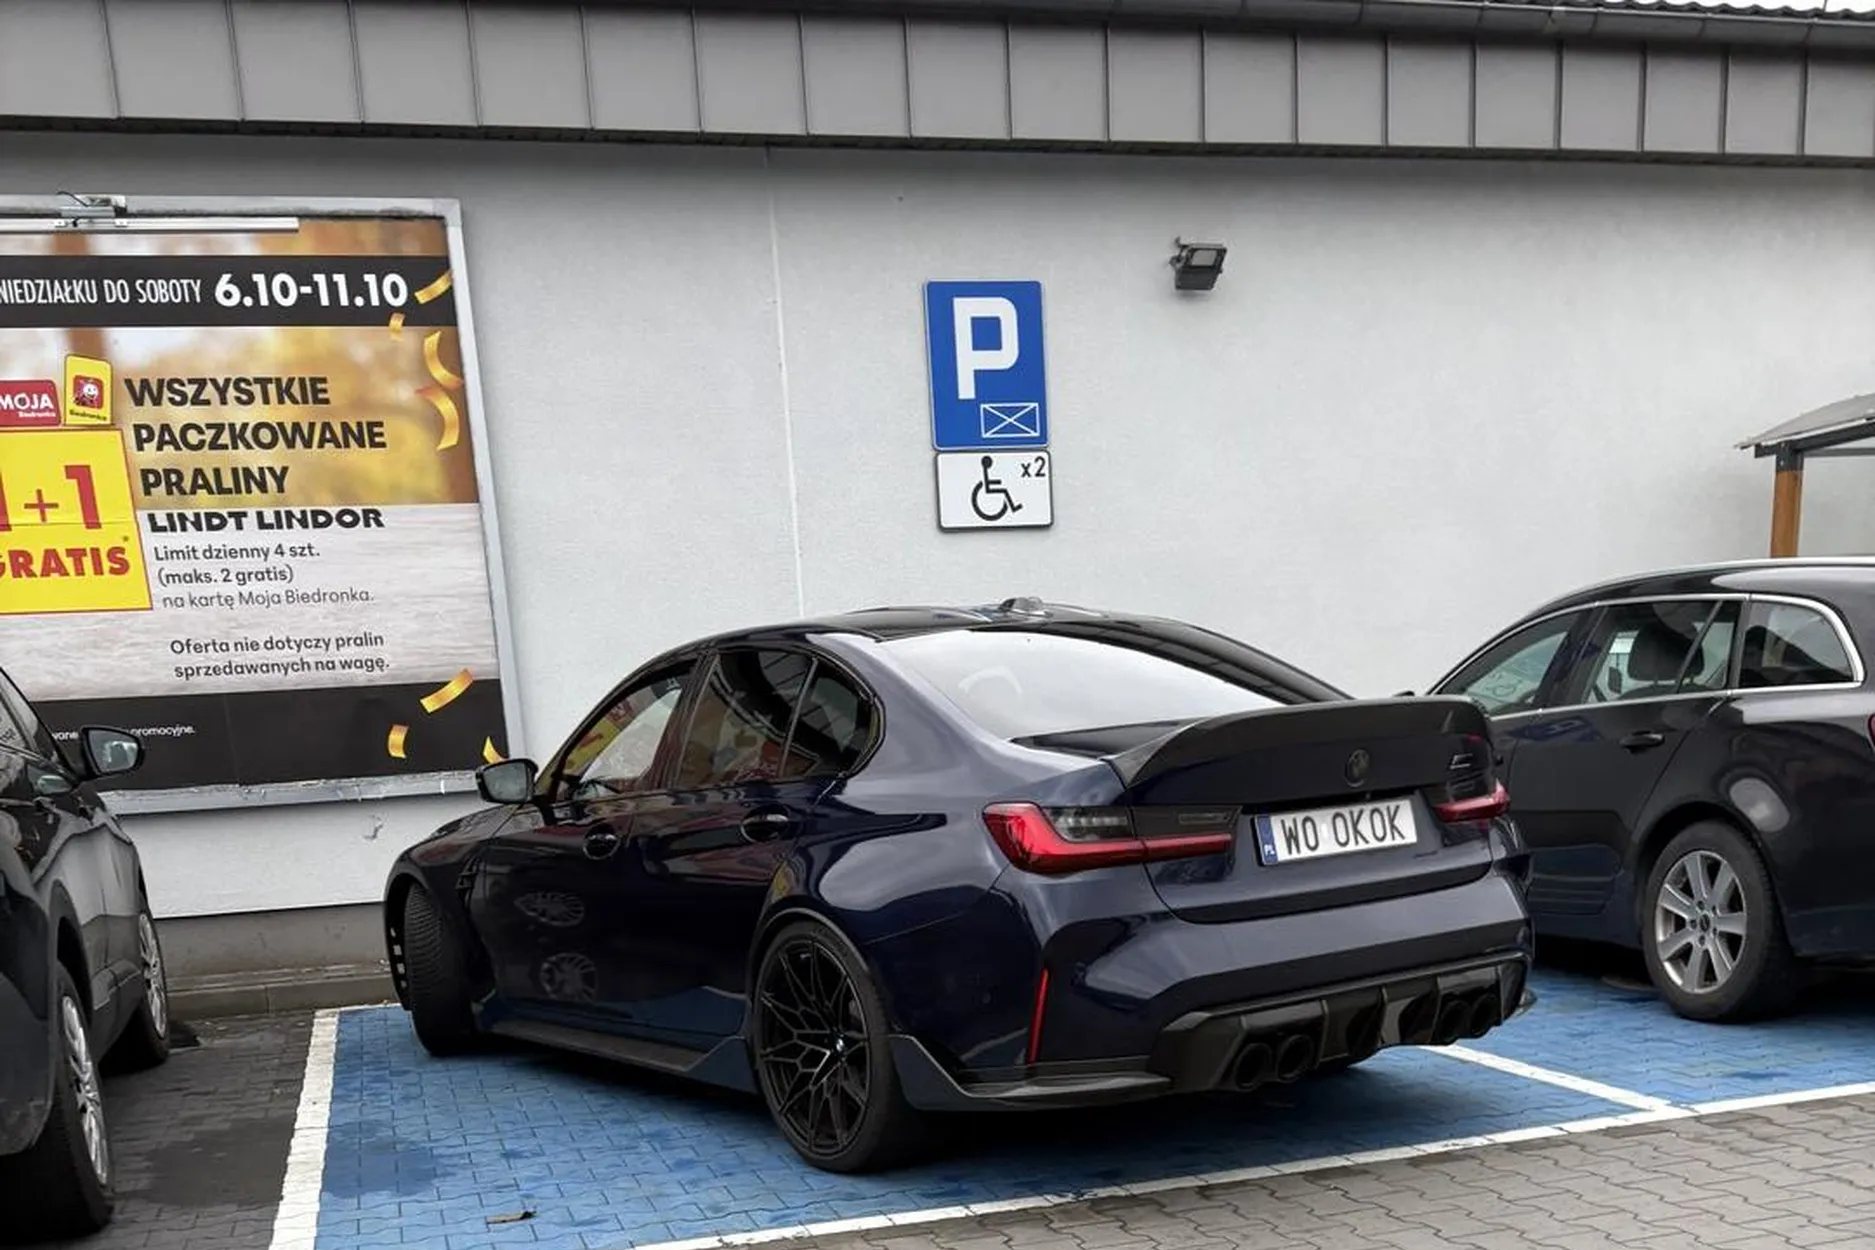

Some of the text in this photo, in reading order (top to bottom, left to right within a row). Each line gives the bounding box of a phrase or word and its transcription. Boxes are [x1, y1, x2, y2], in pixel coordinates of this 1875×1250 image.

[103, 279, 130, 303] DO
[135, 279, 201, 303] SOBOTY
[214, 273, 408, 307] 6.10-11.10
[952, 296, 1019, 400] P
[0, 393, 54, 410] MOJA
[124, 377, 330, 406] WSZYSTKIE
[132, 421, 387, 451] PACZKOWANE
[1020, 456, 1046, 478] x2
[140, 466, 289, 496] PRALINY
[147, 508, 385, 533] LINDT LINDOR
[153, 542, 320, 562] Limit dzienny 4 szt.
[158, 564, 294, 587] (maks. 2 gratis)
[163, 587, 374, 610] na kartę Moja Biedronka.
[170, 632, 384, 655] Oferta nie dotyczy pralin
[174, 655, 390, 680] sprzedawanych na wagę.
[1331, 805, 1406, 847] OKOK
